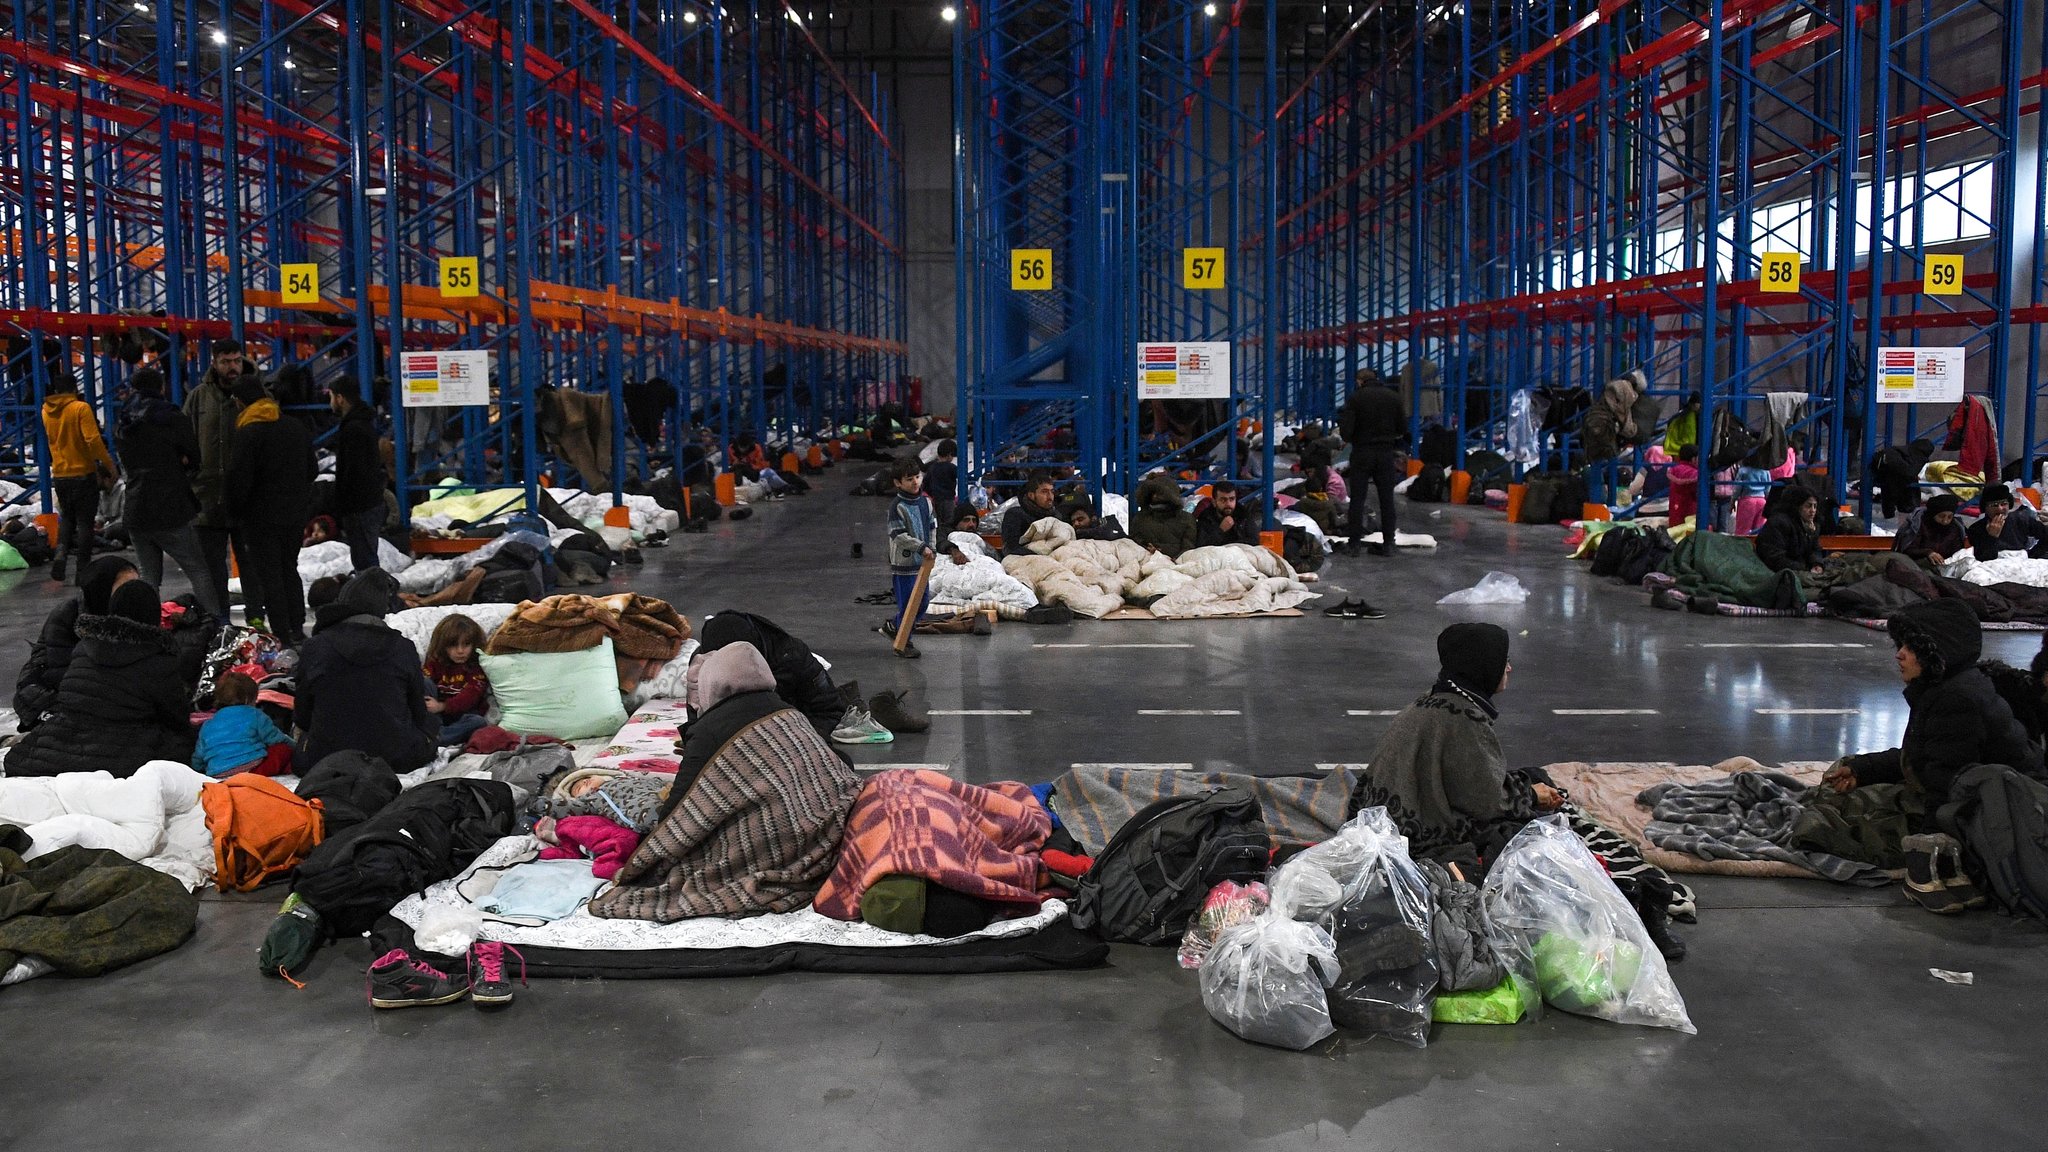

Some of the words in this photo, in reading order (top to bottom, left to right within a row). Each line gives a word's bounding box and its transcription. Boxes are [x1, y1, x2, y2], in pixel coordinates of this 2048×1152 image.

[448, 266, 471, 288] 55
[1020, 258, 1045, 281] 56
[1192, 257, 1217, 280] 57
[1768, 261, 1792, 283] 58
[1932, 264, 1955, 286] 59
[289, 273, 311, 294] 54
